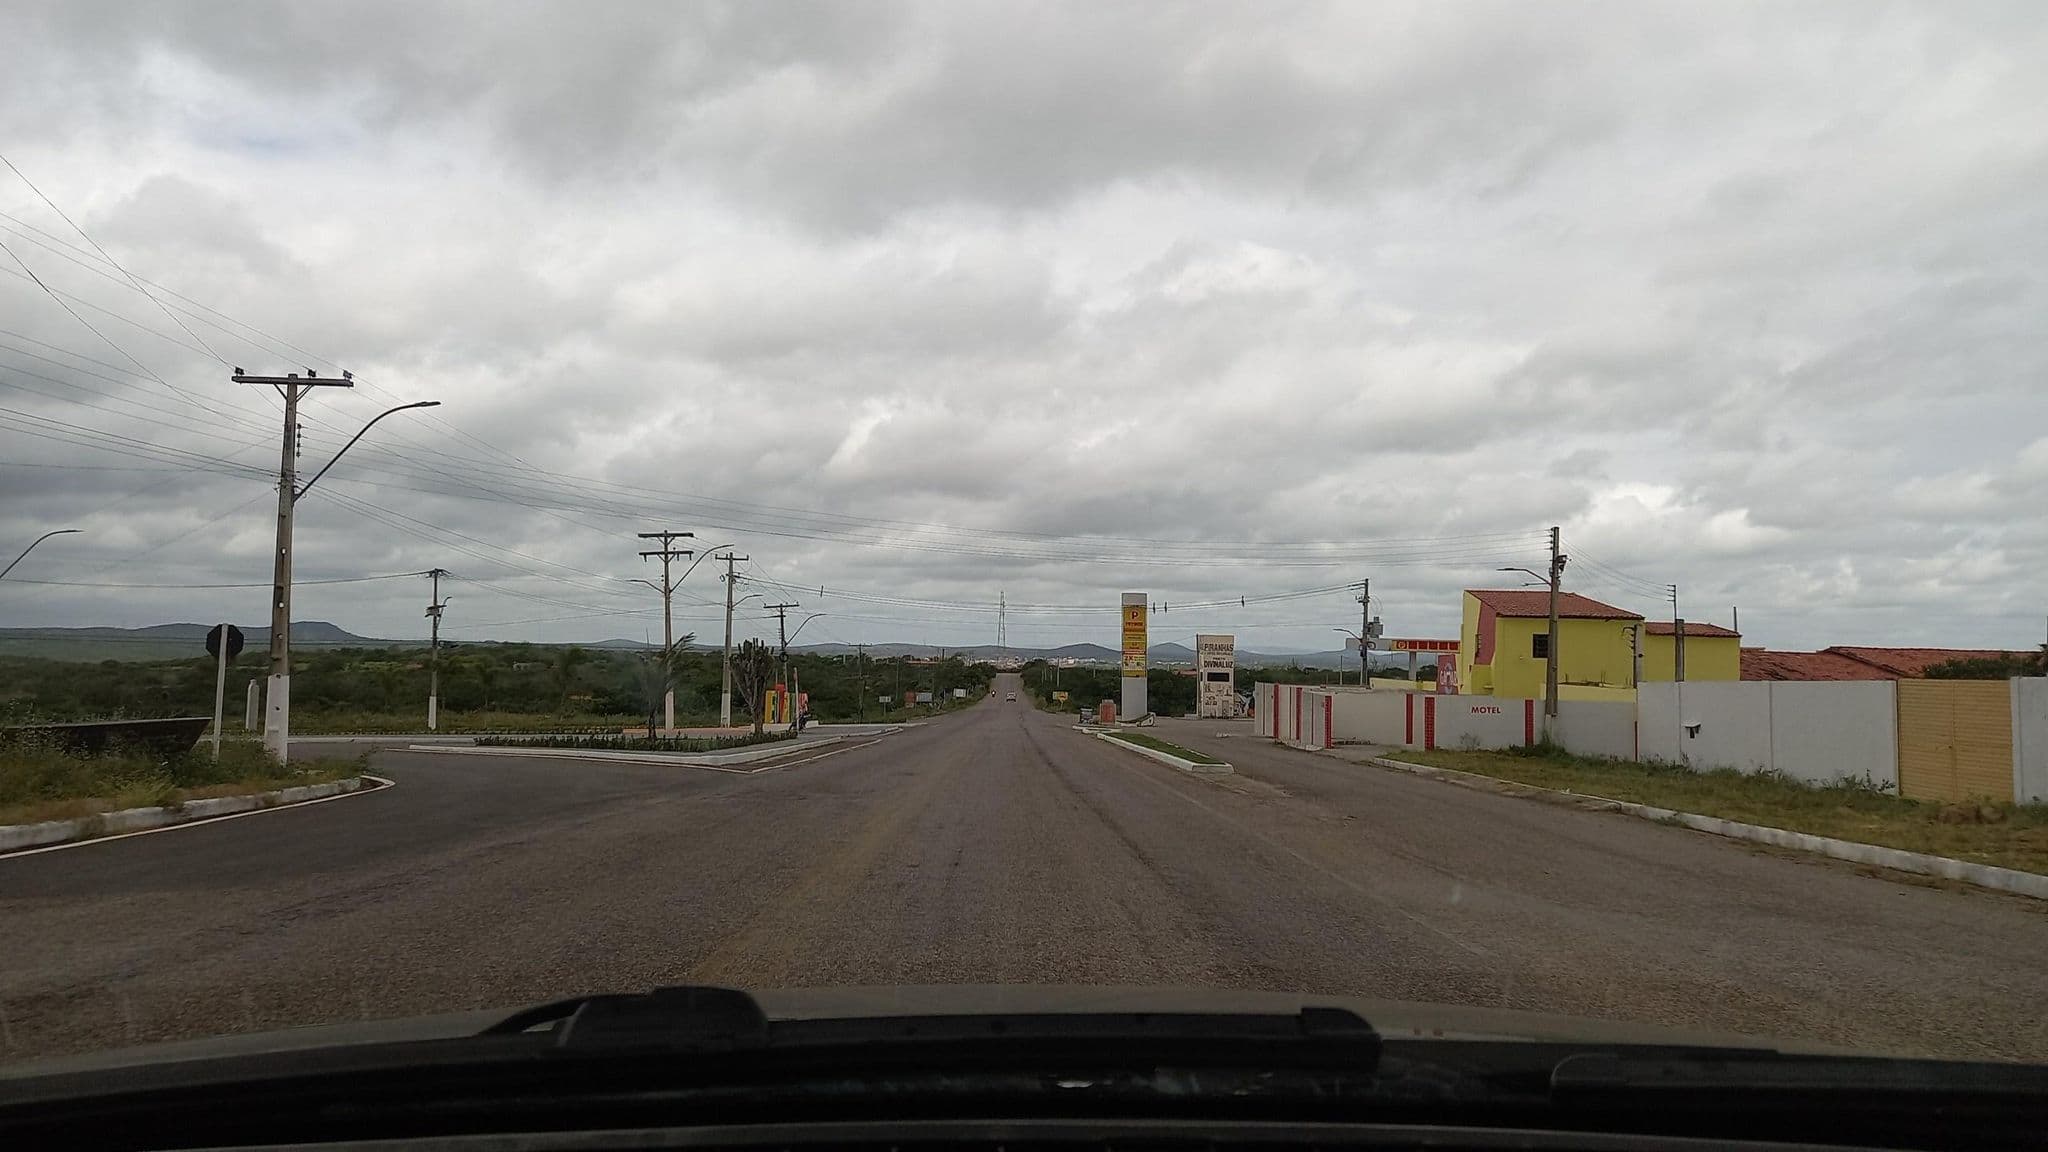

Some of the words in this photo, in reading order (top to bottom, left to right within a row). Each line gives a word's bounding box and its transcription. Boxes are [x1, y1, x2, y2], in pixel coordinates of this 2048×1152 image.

[1131, 611, 1139, 619] P
[1204, 643, 1234, 652] PIRANHAS
[1471, 706, 1501, 714] MOTEL
